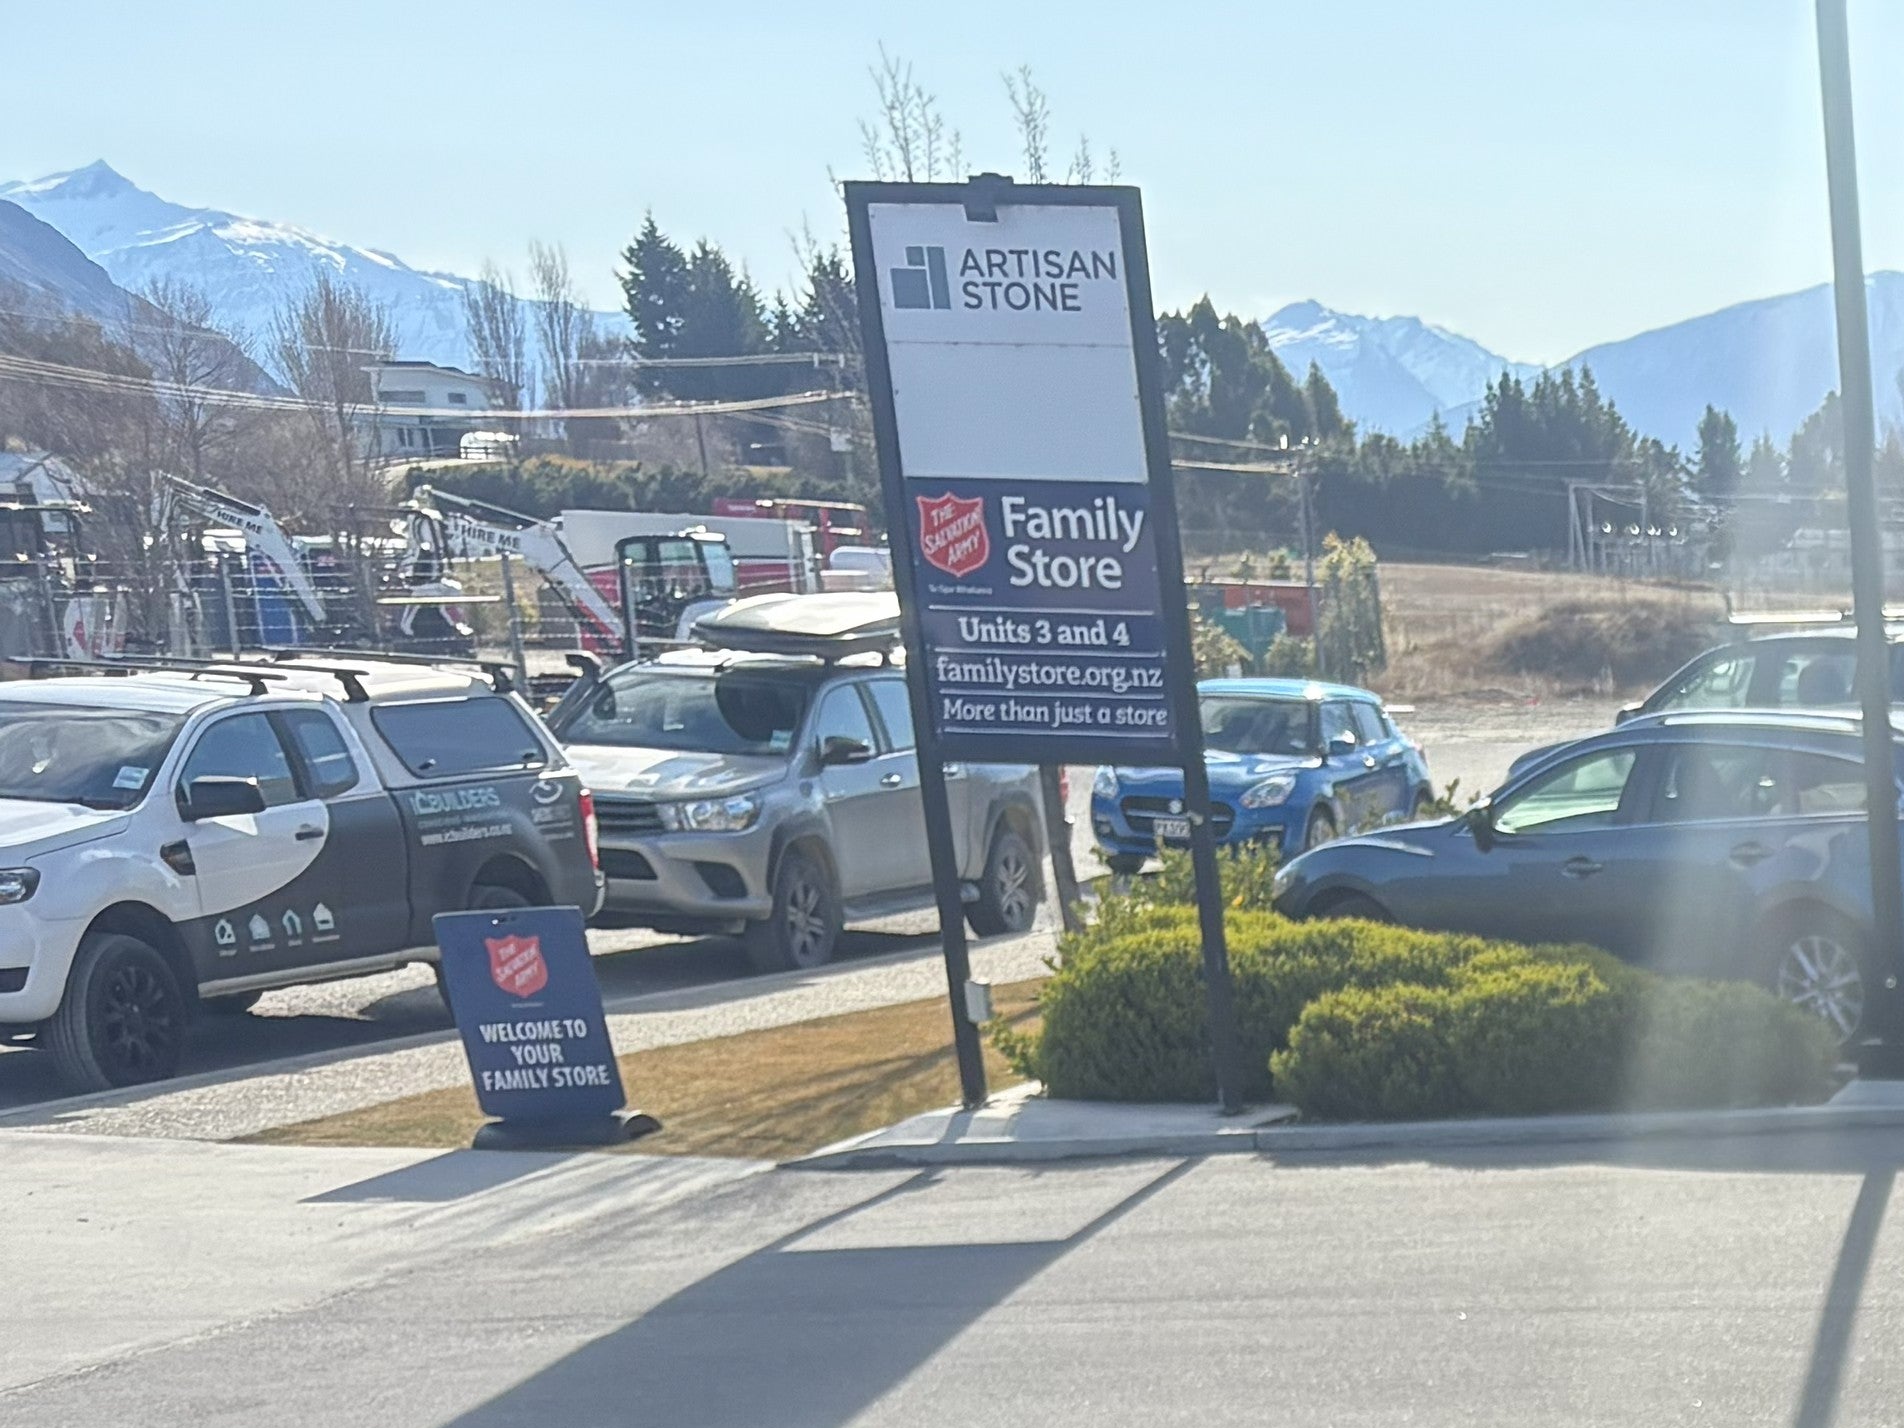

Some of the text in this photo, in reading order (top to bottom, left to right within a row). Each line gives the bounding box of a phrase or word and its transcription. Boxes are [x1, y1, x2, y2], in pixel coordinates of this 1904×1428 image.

[959, 248, 1117, 280] ARTISAN
[962, 280, 1082, 312] STONE
[930, 502, 957, 528] THE
[1001, 495, 1145, 552] Family
[498, 533, 521, 550] ME
[946, 529, 981, 567] ARMY
[1006, 544, 1123, 590] Store
[958, 616, 1131, 647] Units 3 and 4
[936, 656, 1165, 693] familystore.org.nz
[942, 698, 1169, 728] More than just a store
[479, 1018, 588, 1043] WELCOME TO
[510, 1043, 565, 1066] YOUR
[481, 1064, 611, 1092] FAMILY STORE
